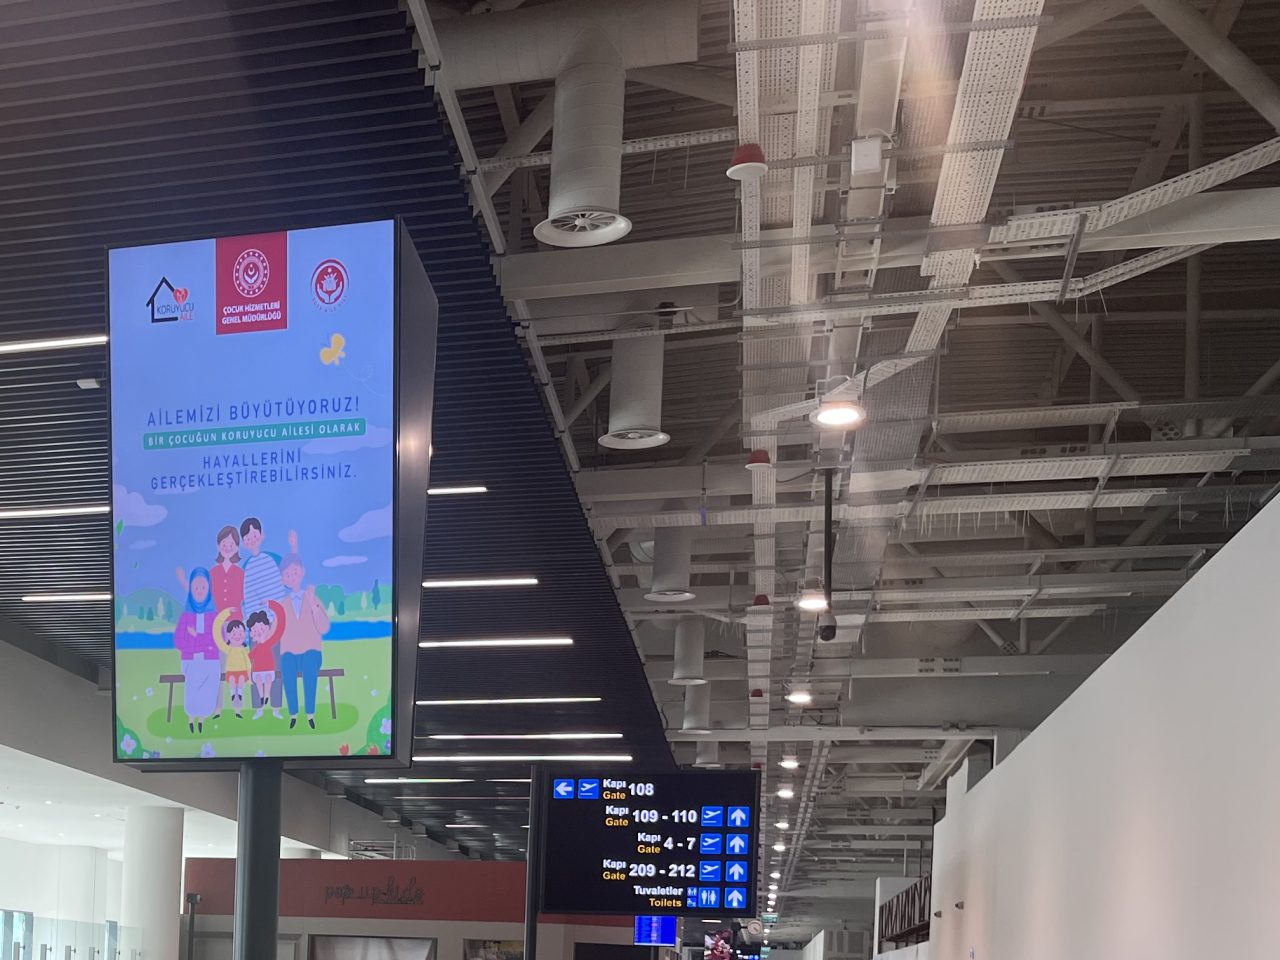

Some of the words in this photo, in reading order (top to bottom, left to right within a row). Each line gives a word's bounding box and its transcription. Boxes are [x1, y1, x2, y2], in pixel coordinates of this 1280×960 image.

[223, 304, 244, 316] ÇOCUK
[221, 316, 242, 325] GENEL
[147, 403, 221, 427] AİLEMİZİ
[229, 395, 360, 421] BÜYÜTÜYORUZ!
[148, 434, 165, 446] BİR
[168, 431, 218, 447] ÇOCUĞUN
[221, 428, 277, 441] KORUYUCU
[281, 424, 314, 438] AİLESİ
[318, 422, 361, 435] OLARAK
[203, 447, 302, 470] HAYALLERİNİ
[150, 462, 357, 491] GERÇEKLEŞTİREBİLİRSİNİZ.
[602, 778, 627, 789] Kapı
[628, 782, 655, 796] 108
[602, 790, 627, 800] Gate
[605, 805, 629, 816] Kapı
[632, 809, 659, 823] 109
[671, 809, 698, 823] 110
[605, 817, 629, 827] Gate
[637, 832, 661, 843] Kapı
[663, 836, 674, 850] 4
[686, 837, 696, 850] 7
[637, 844, 661, 854] Gate
[602, 859, 627, 870] Kapı
[628, 863, 656, 877] 209
[668, 864, 696, 877] 212
[602, 871, 626, 880] Gate
[633, 885, 684, 896] Tuvaletler
[649, 898, 682, 908] Toilets
